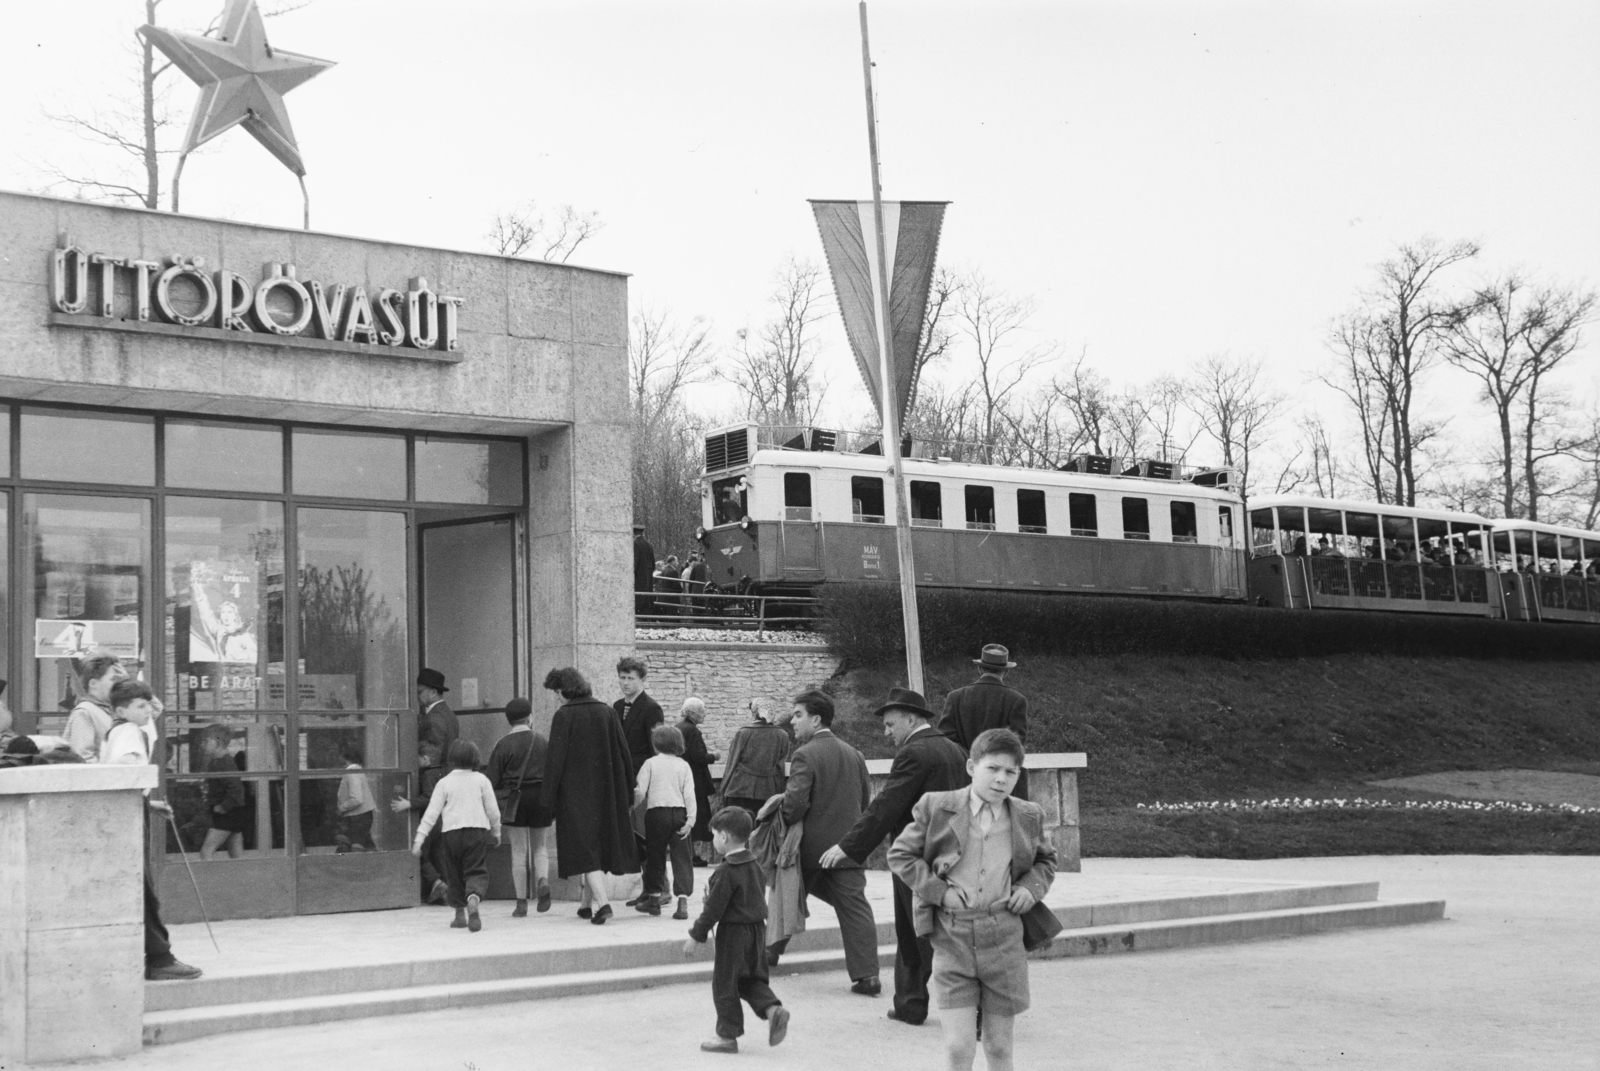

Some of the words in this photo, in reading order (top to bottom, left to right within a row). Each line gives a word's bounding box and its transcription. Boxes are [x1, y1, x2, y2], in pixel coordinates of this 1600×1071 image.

[48, 232, 464, 352] ÚTTÖRŐVASÚT
[863, 543, 879, 555] MÁV
[229, 582, 242, 598] 4
[53, 621, 98, 656] 4
